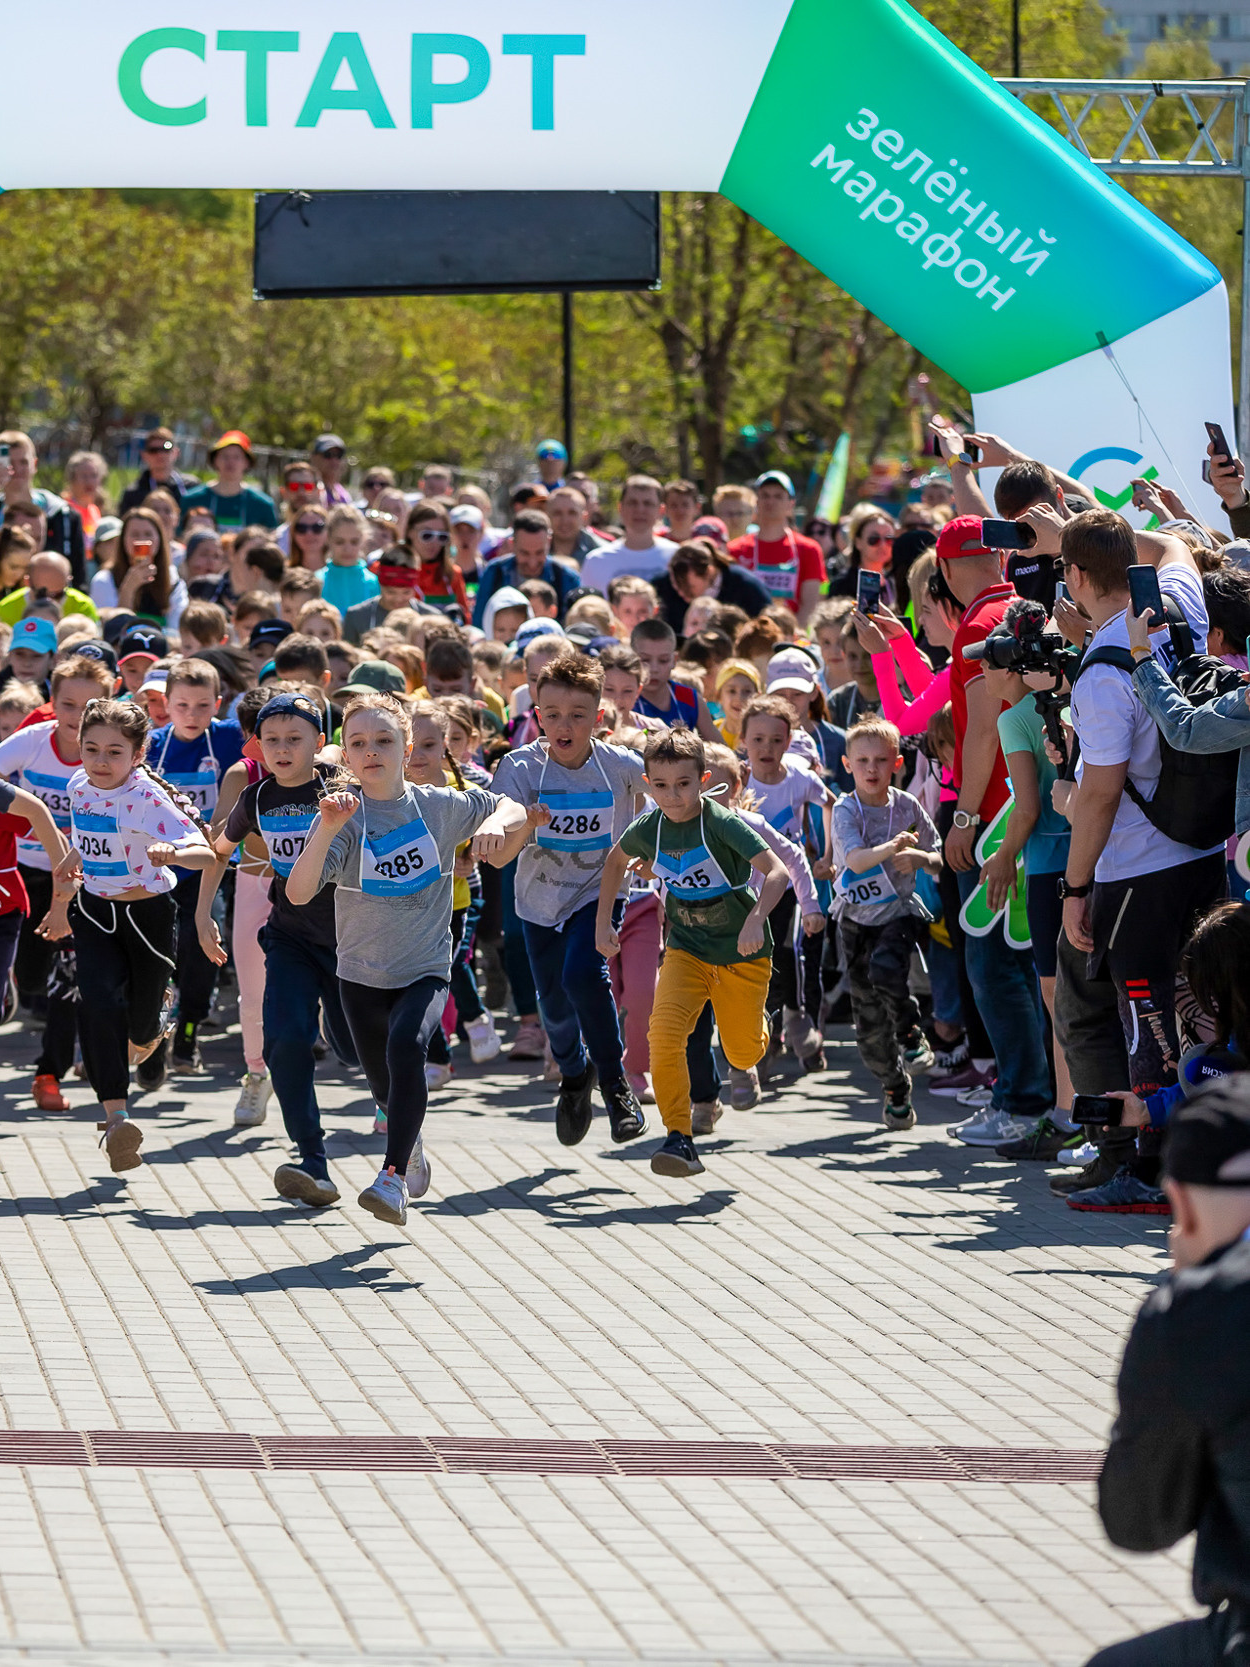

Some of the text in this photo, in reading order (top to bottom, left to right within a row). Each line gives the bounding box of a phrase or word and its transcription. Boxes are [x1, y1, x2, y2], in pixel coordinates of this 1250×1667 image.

[118, 27, 586, 131] СТАРТ
[810, 143, 1017, 312] марафон
[845, 107, 1058, 277] зелёный
[1015, 563, 1040, 576] macron
[549, 814, 601, 834] 4286
